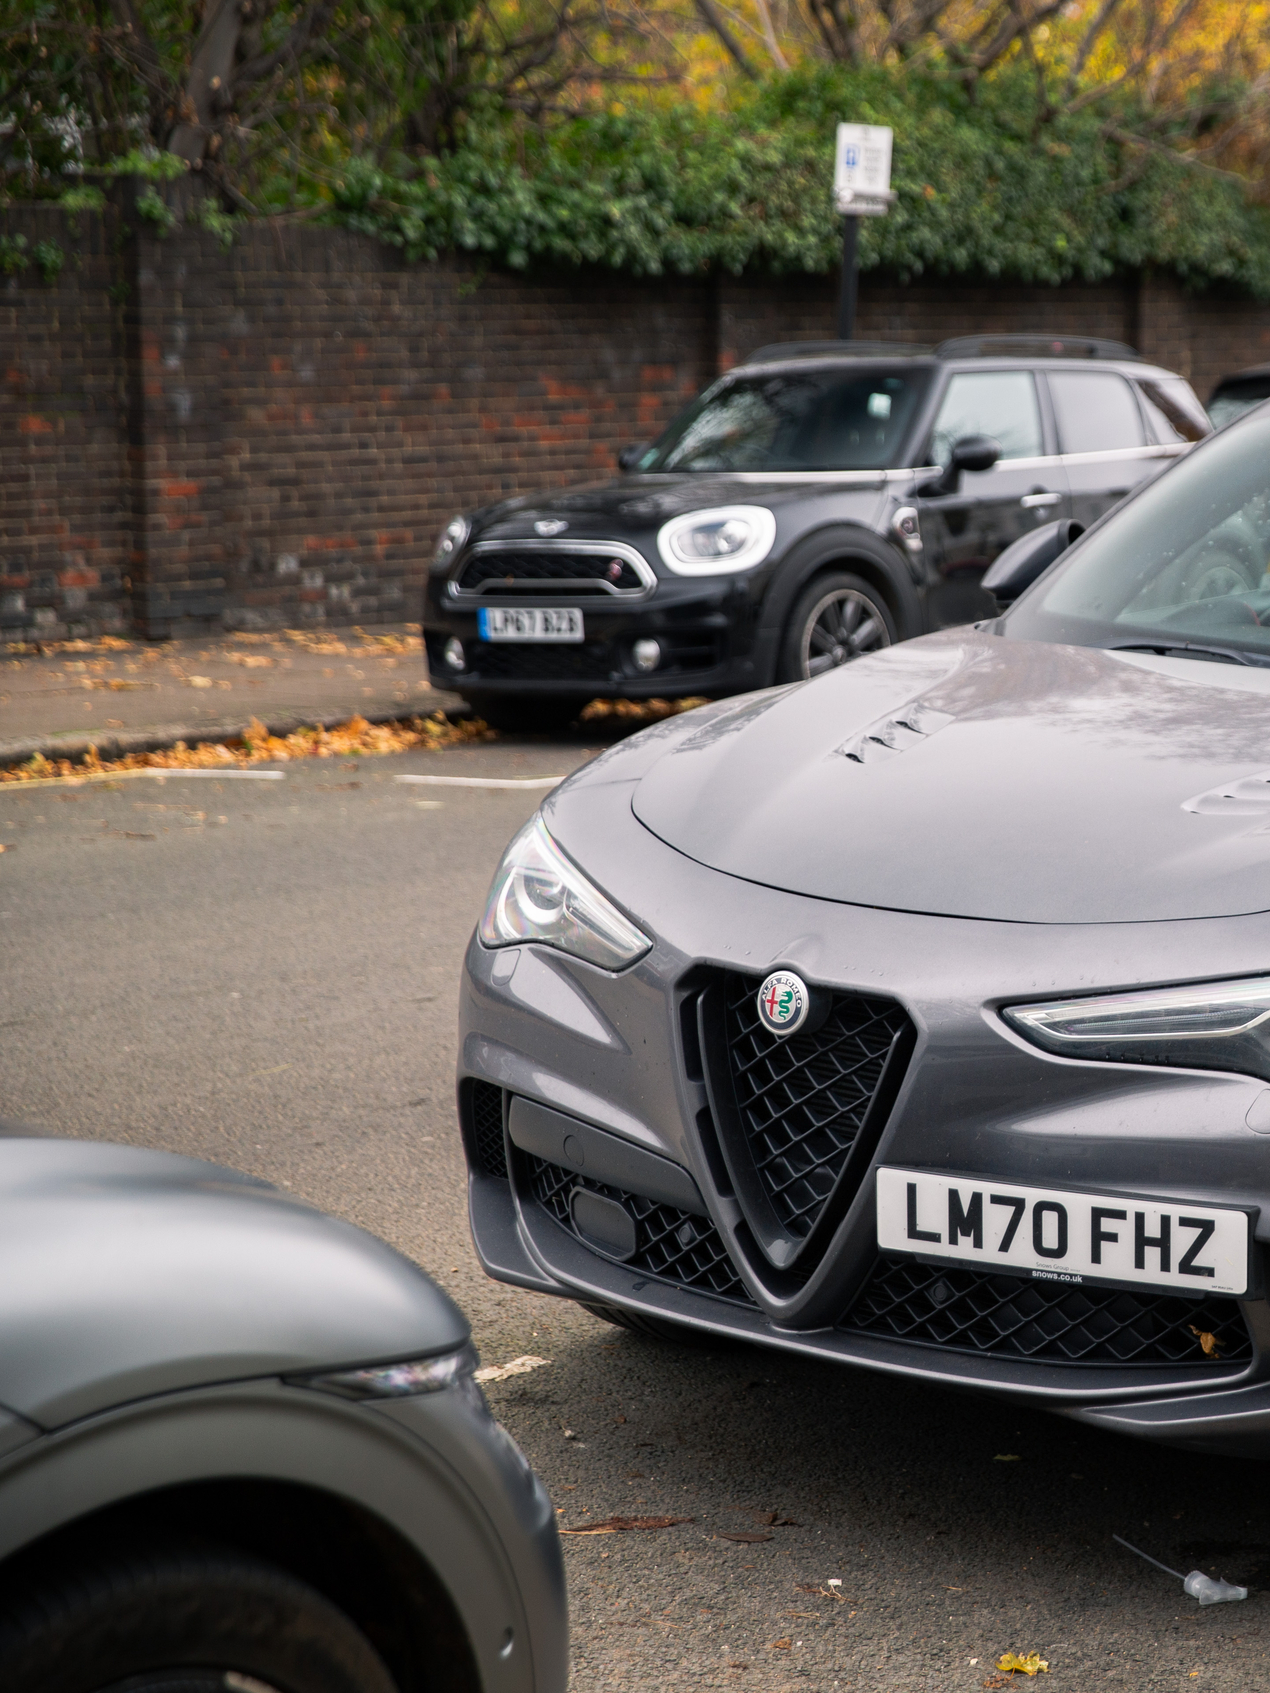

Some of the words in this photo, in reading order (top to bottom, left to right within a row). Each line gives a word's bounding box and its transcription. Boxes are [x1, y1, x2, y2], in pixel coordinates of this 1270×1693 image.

[491, 608, 535, 634] LP67
[762, 979, 778, 1001] ALFA
[781, 977, 802, 1008] ROMEO
[906, 1182, 1068, 1260] LM70
[1090, 1206, 1216, 1278] FHZ
[1031, 1270, 1083, 1283] snows.co.uk
